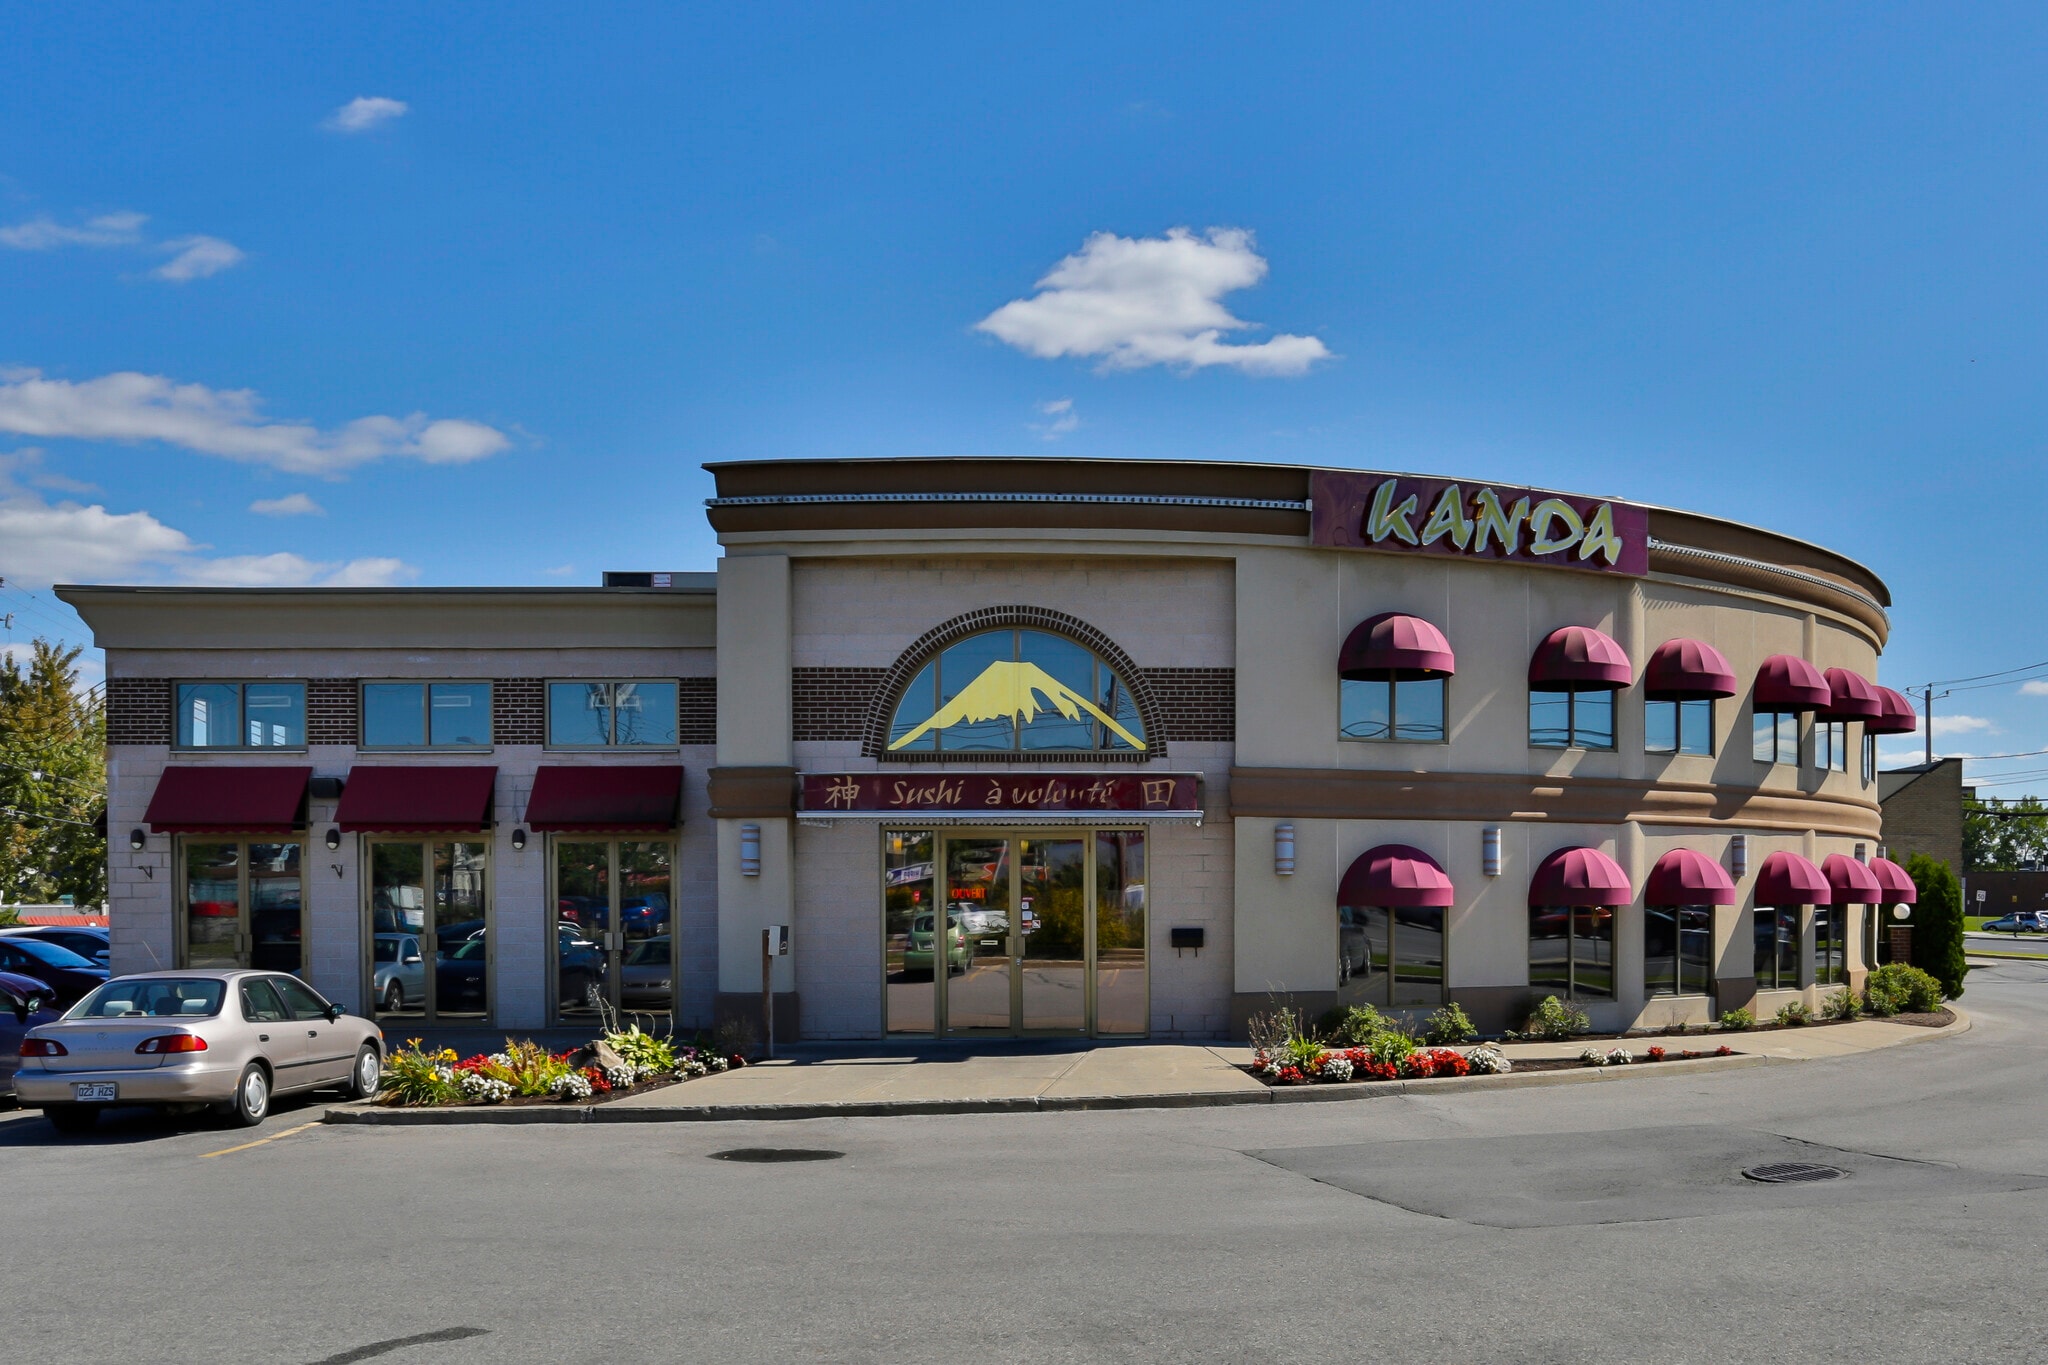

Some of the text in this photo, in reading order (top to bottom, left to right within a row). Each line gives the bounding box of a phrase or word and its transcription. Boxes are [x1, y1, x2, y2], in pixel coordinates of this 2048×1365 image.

[1366, 478, 1623, 566] KANDA
[825, 775, 860, 810] 神
[889, 779, 1116, 805] Sushi à volonté
[1142, 779, 1177, 807] 田
[951, 887, 986, 899] OUVERT
